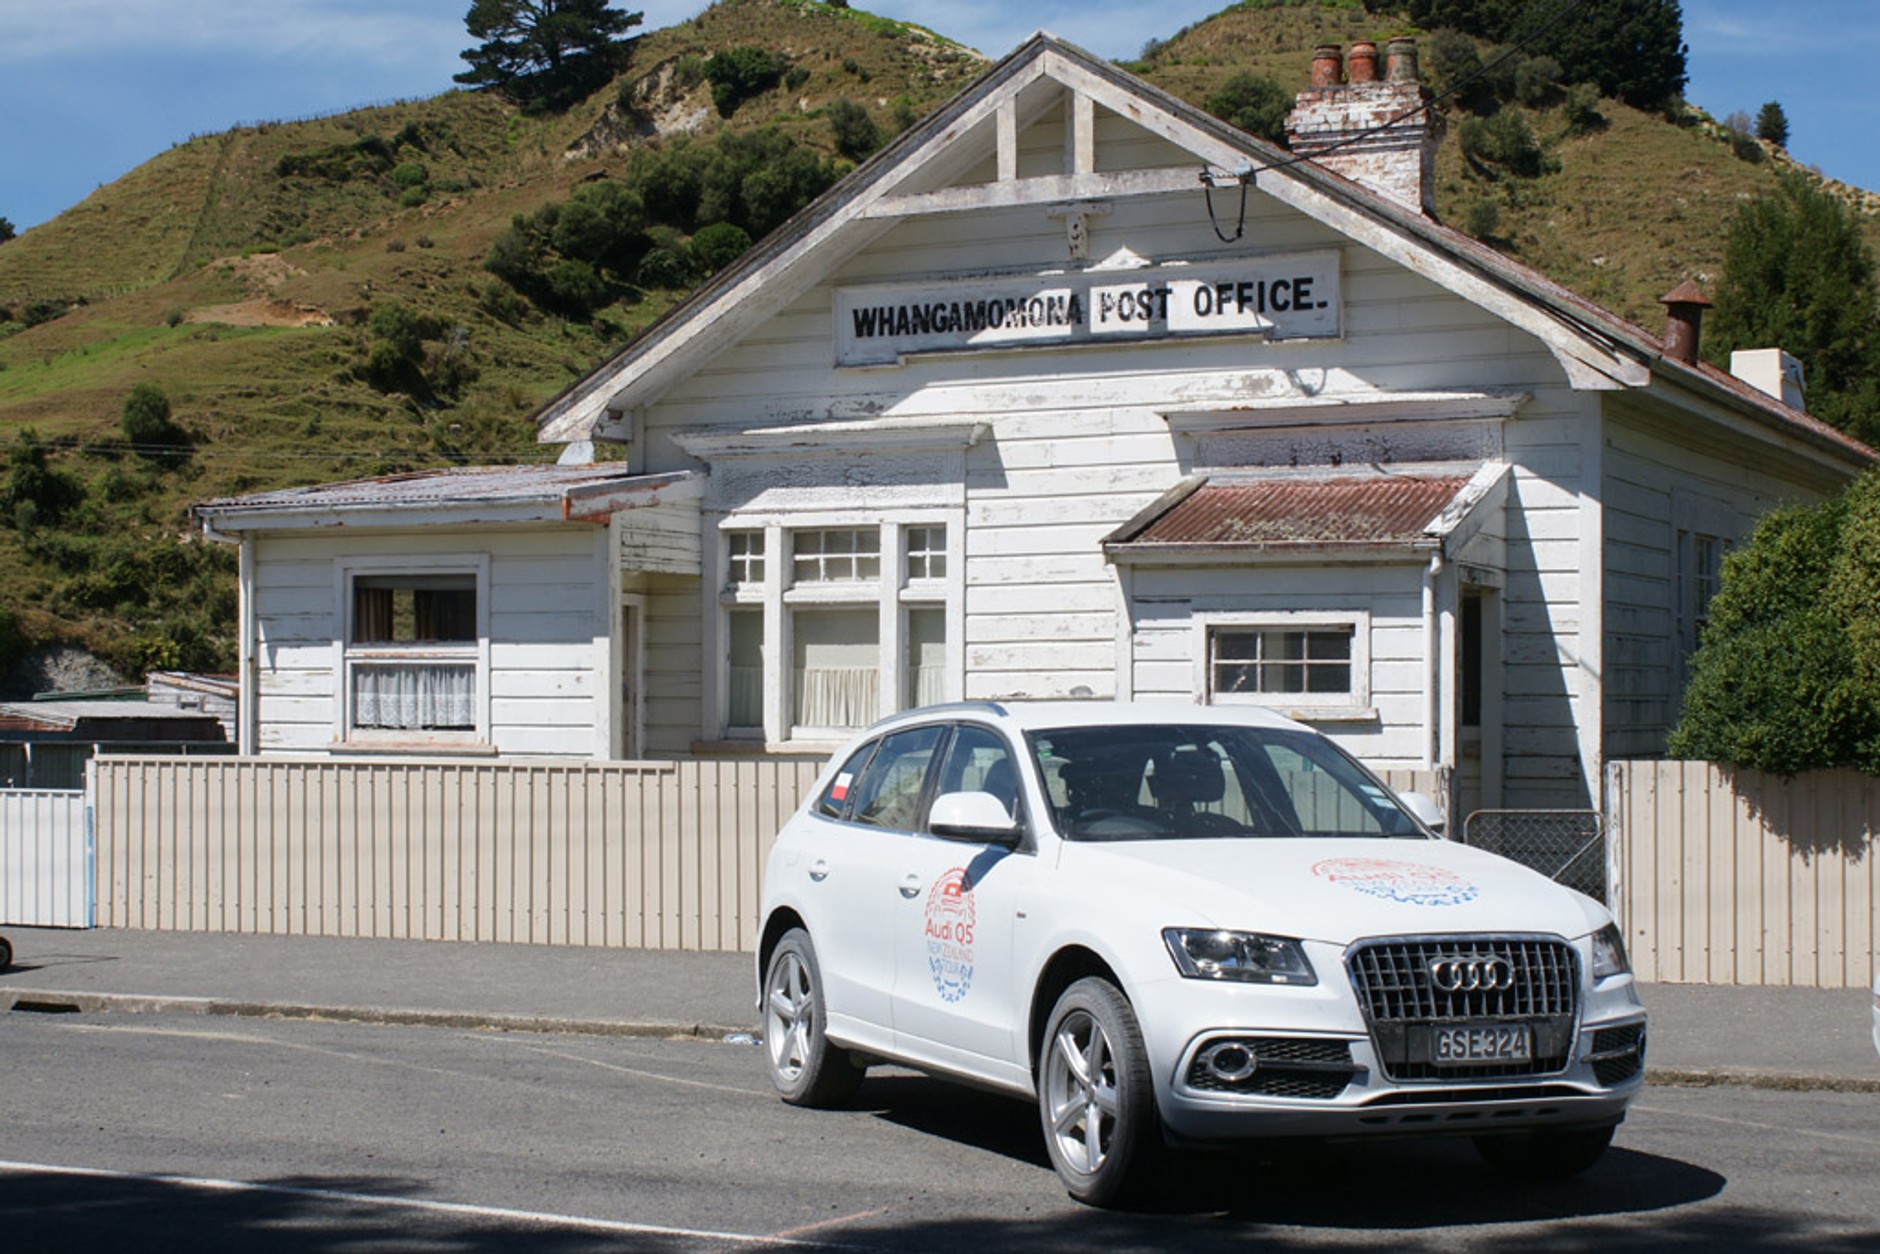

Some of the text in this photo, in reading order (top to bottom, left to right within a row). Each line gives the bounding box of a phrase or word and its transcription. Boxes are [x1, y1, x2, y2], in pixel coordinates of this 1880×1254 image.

[852, 293, 1083, 338] WHANGAMOMONA
[1100, 287, 1172, 322] POST
[925, 918, 974, 946] Audi Q5
[1437, 1028, 1527, 1058] GSE324
